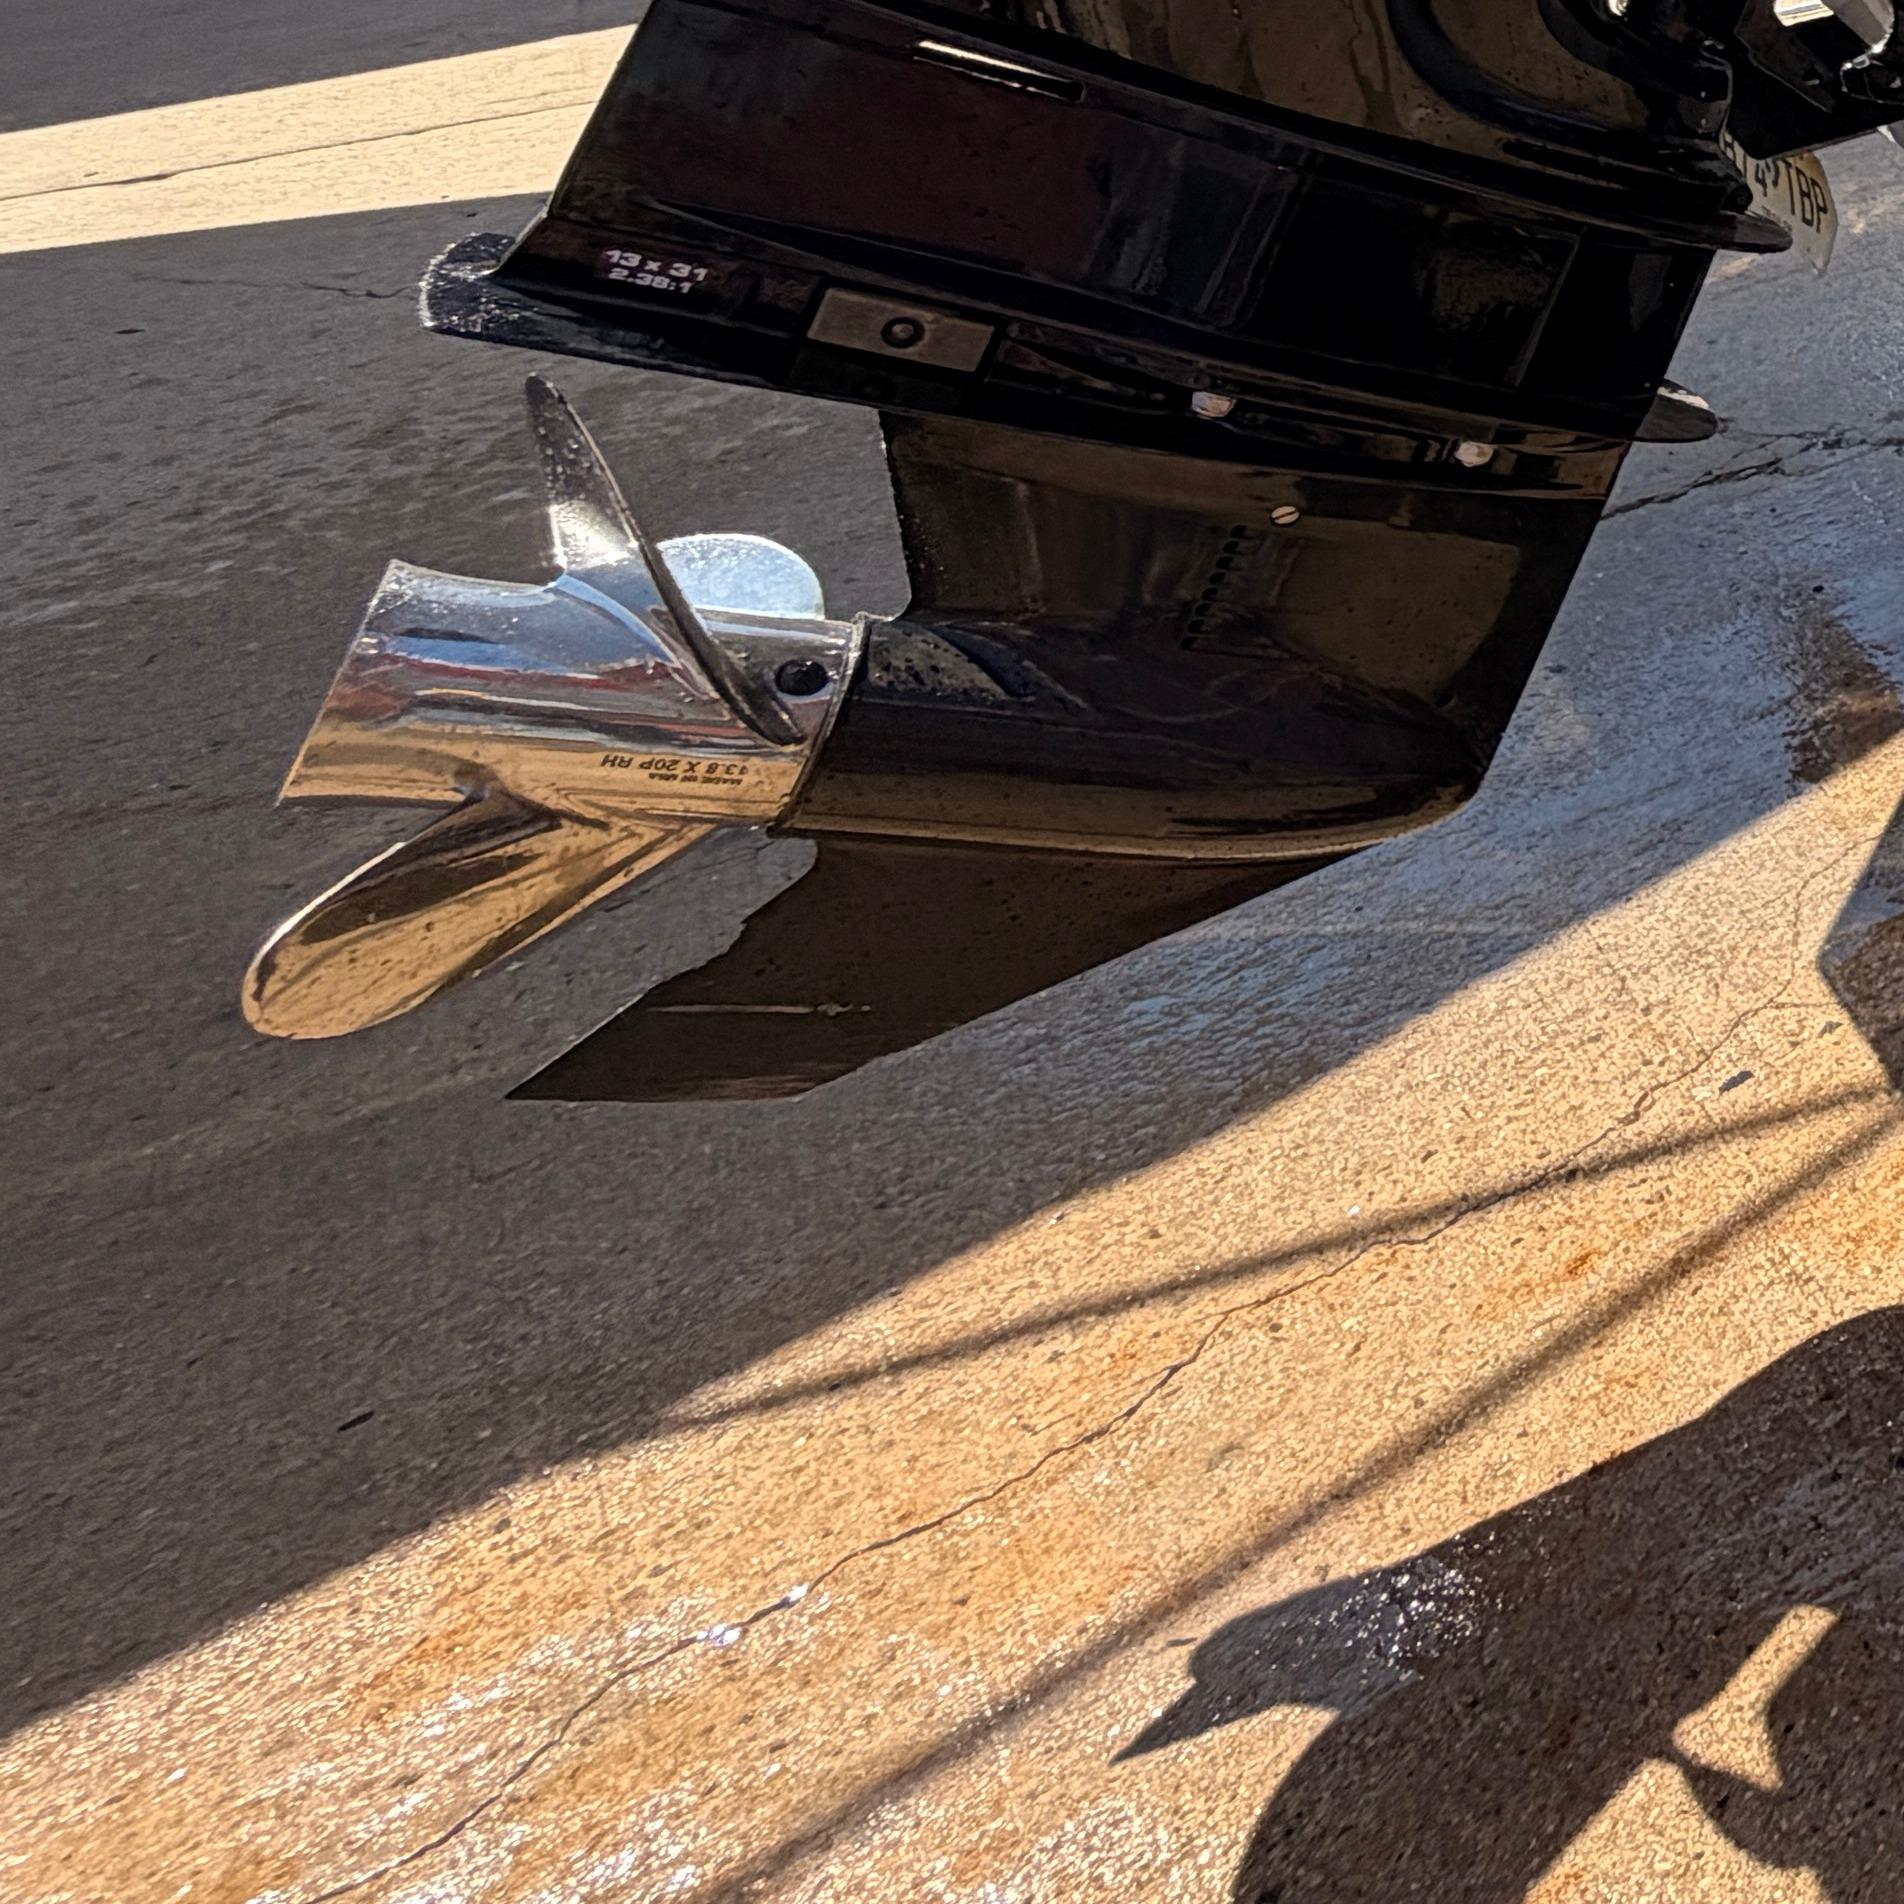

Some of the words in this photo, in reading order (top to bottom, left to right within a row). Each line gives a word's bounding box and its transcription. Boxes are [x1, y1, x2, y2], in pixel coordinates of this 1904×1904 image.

[605, 248, 643, 268] 13
[668, 262, 709, 282] 31
[599, 753, 635, 769] RH
[638, 757, 681, 772] 20P
